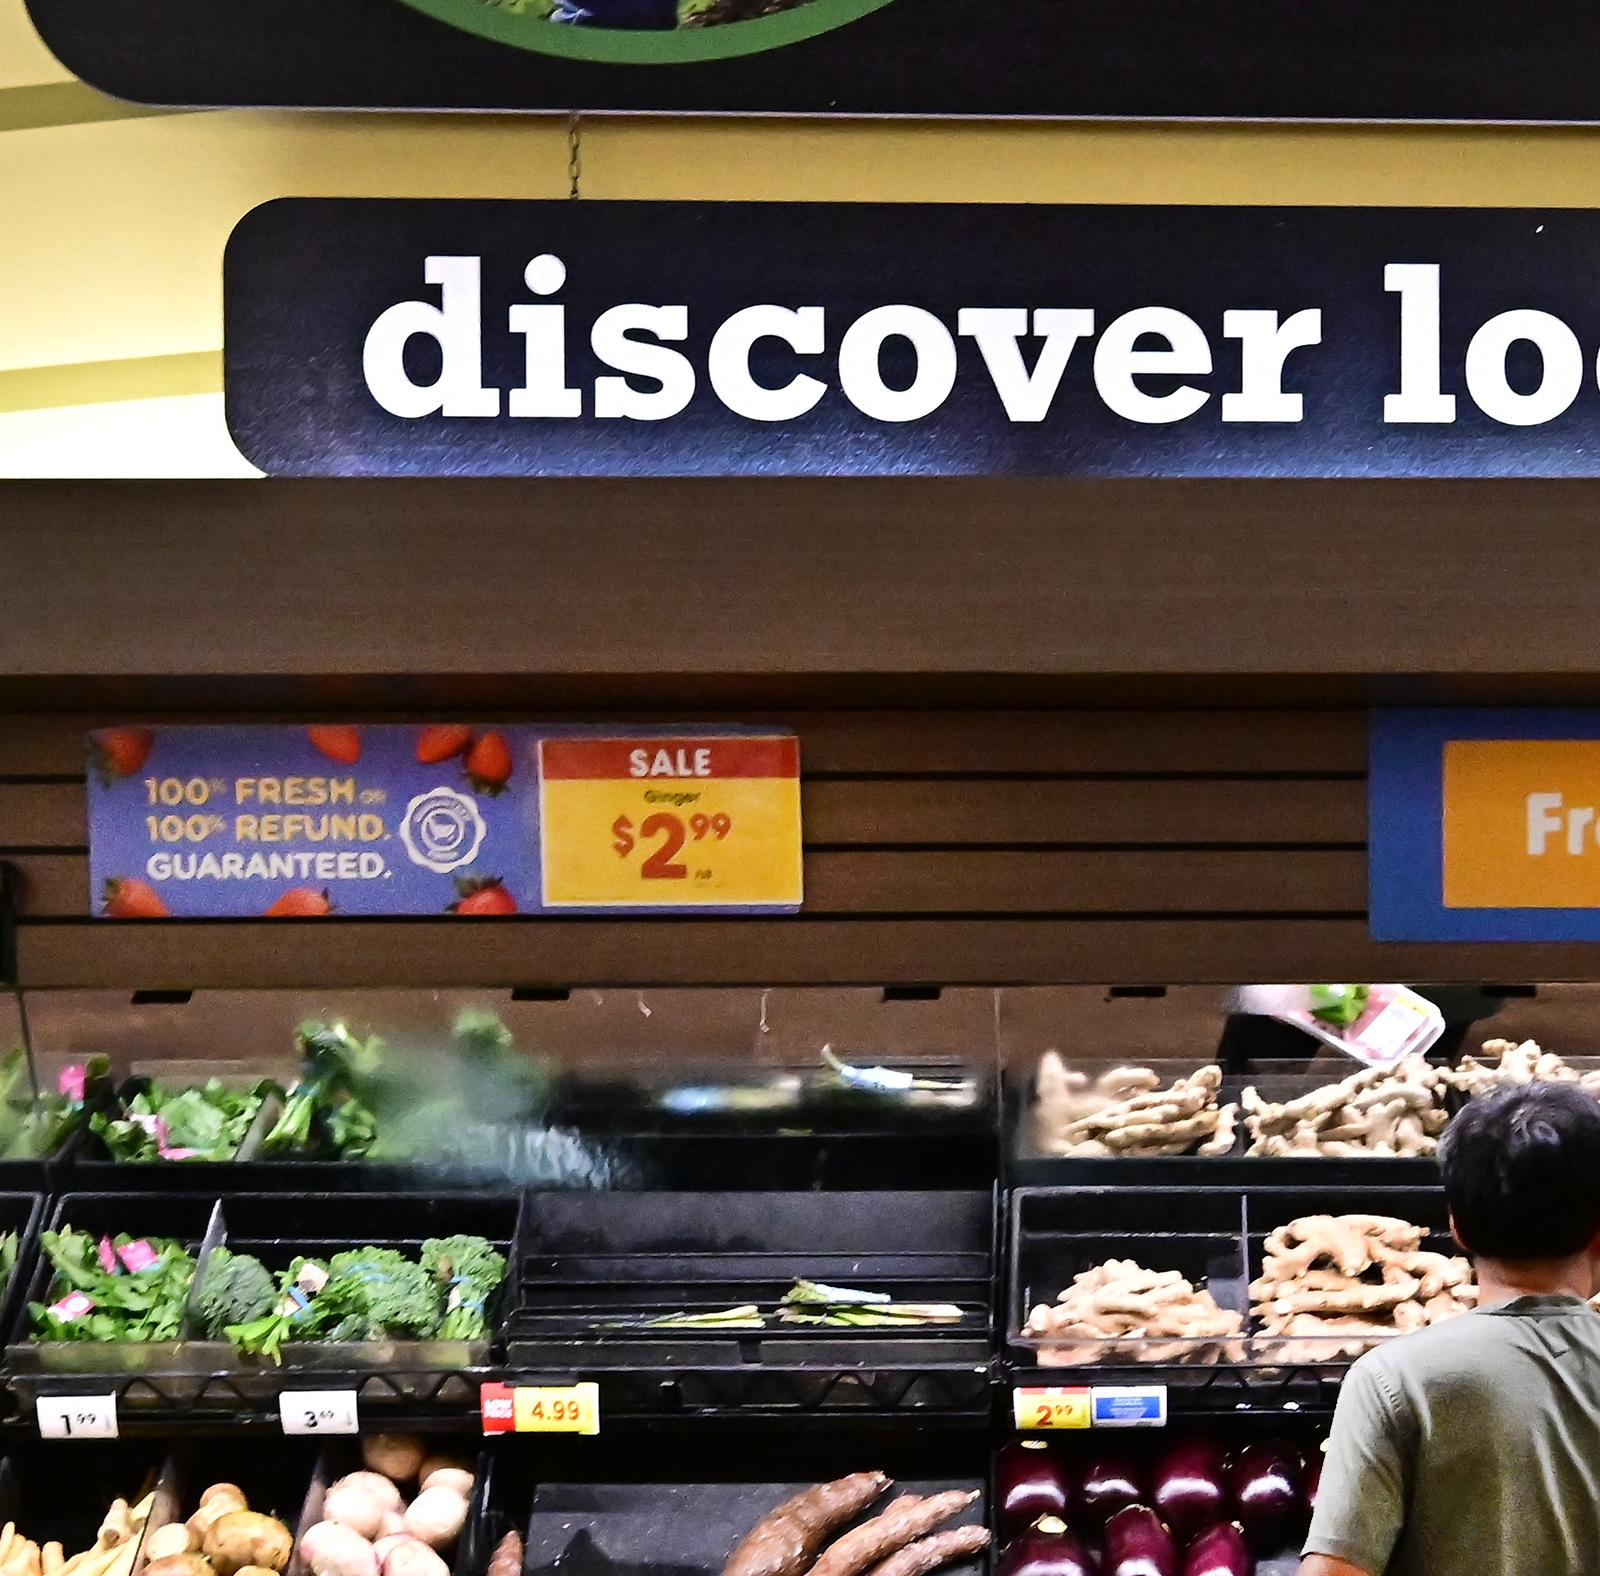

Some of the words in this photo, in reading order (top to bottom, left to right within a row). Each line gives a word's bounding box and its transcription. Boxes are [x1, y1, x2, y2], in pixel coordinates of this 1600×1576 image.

[364, 255, 1321, 424] discover
[631, 749, 711, 777] SALE
[145, 777, 226, 806] 100%
[235, 777, 355, 805] FRESH
[146, 814, 226, 842] 100%
[236, 814, 392, 842] REFUND.
[147, 851, 392, 881] GUARANTEED.
[532, 1400, 580, 1421] 4.99
